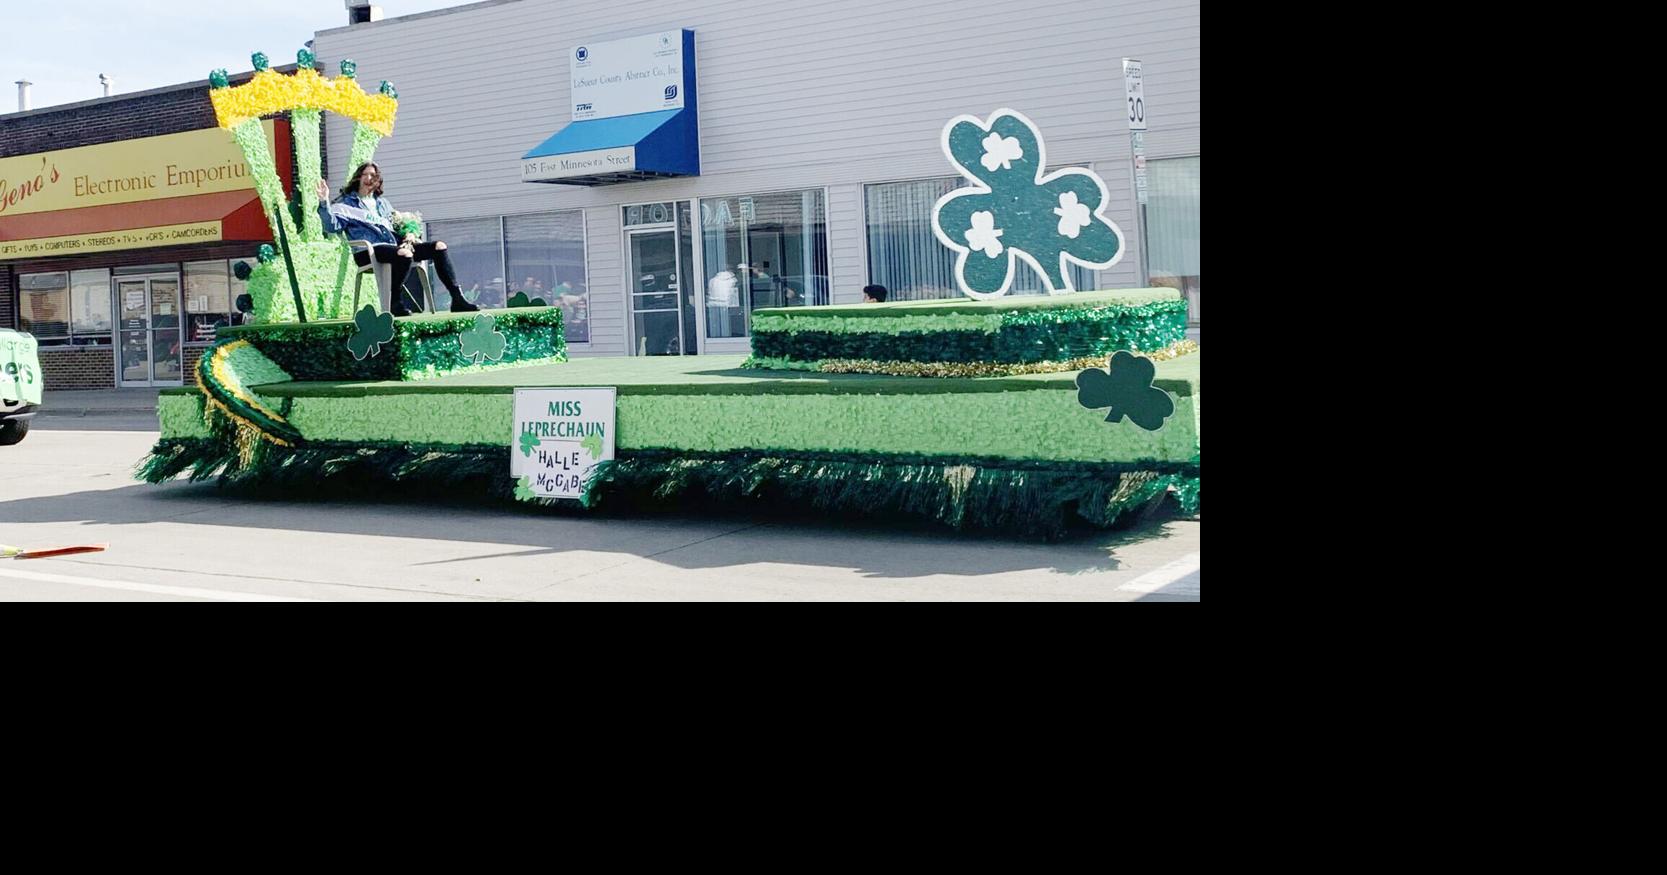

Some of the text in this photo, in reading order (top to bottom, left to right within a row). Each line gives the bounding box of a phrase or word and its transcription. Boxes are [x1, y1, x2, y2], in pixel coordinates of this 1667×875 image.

[1128, 97, 1144, 122] 30
[524, 163, 537, 174] 105
[560, 158, 603, 171] Minnesota
[606, 154, 631, 165] Street
[74, 159, 252, 197] Electronic Emporiu
[44, 239, 81, 250] COMPUTERS
[87, 236, 116, 247] STEREOS
[171, 226, 218, 239] CAMCORDERS
[547, 401, 582, 417] MISS
[521, 421, 605, 438] LEPRECHAUN
[538, 450, 580, 471] HALLE
